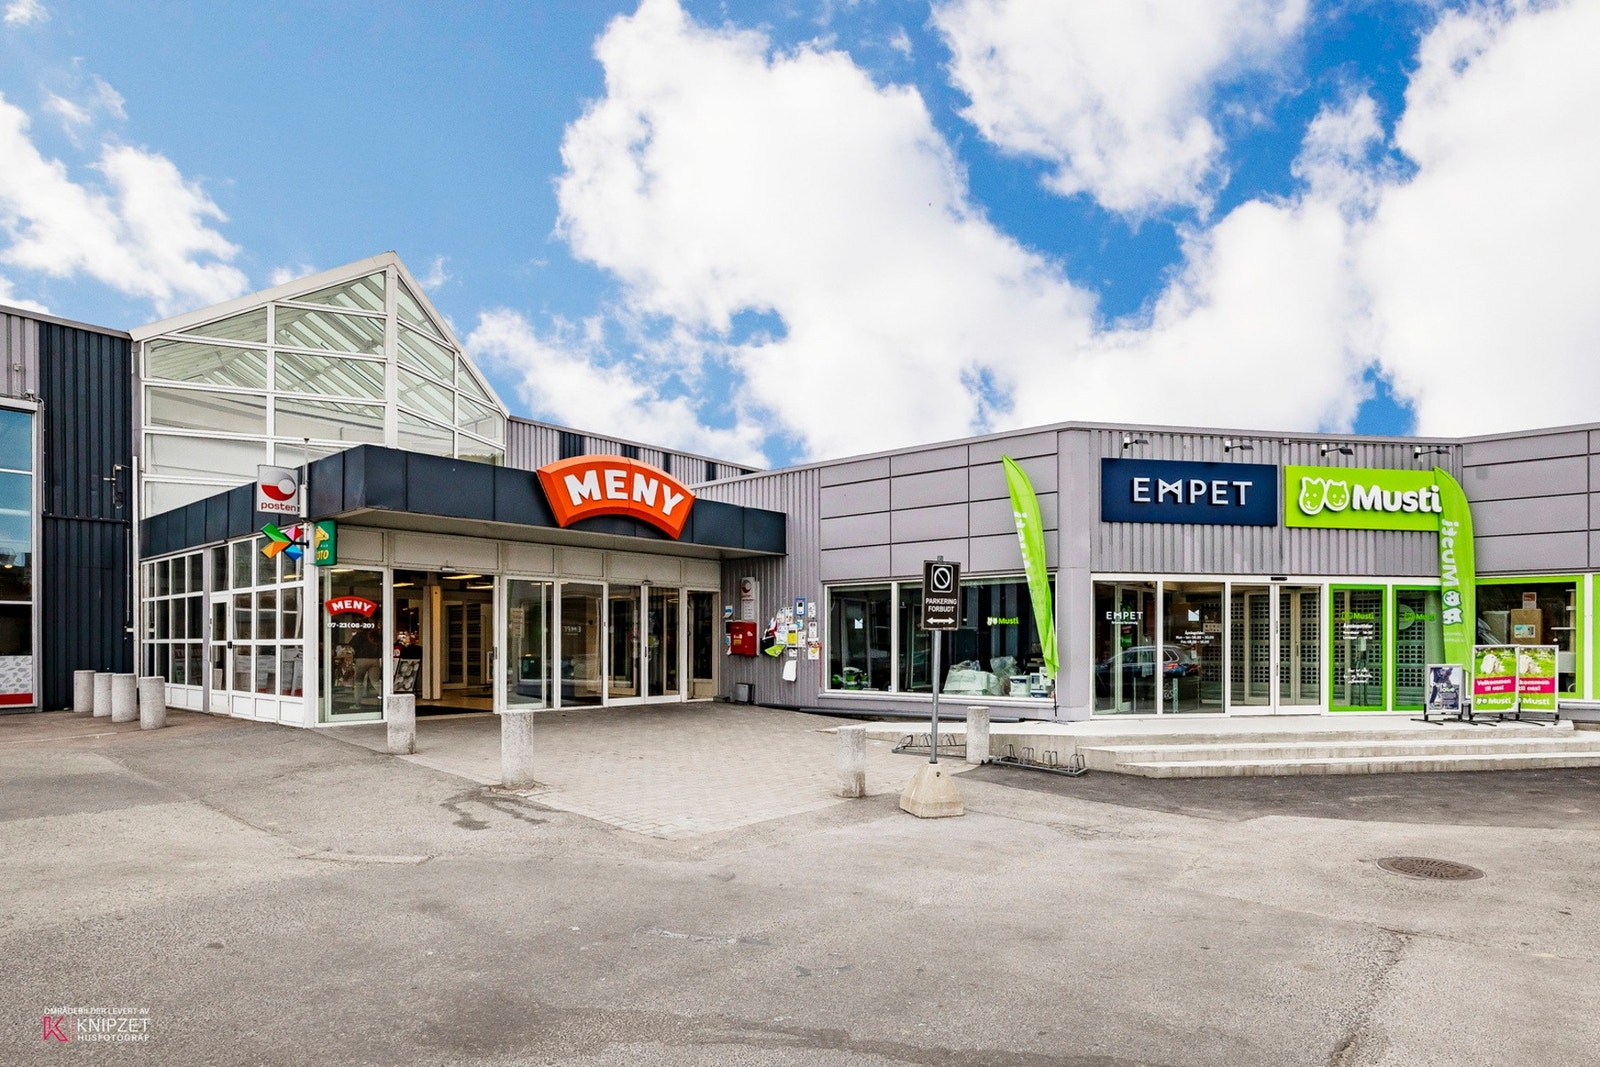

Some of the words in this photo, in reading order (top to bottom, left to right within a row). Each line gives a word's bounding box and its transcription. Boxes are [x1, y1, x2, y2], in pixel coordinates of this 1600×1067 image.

[563, 469, 685, 516] MENY
[1133, 477, 1252, 506] EMPET
[1352, 484, 1442, 513] Musti
[261, 502, 296, 511] posten
[331, 599, 372, 612] MENY
[925, 597, 957, 605] PARKERING
[928, 605, 954, 613] FORBUDT
[1106, 611, 1143, 620] EMPET
[999, 617, 1019, 625] Musti
[1488, 697, 1511, 705] Musti
[1523, 697, 1550, 705] Musti
